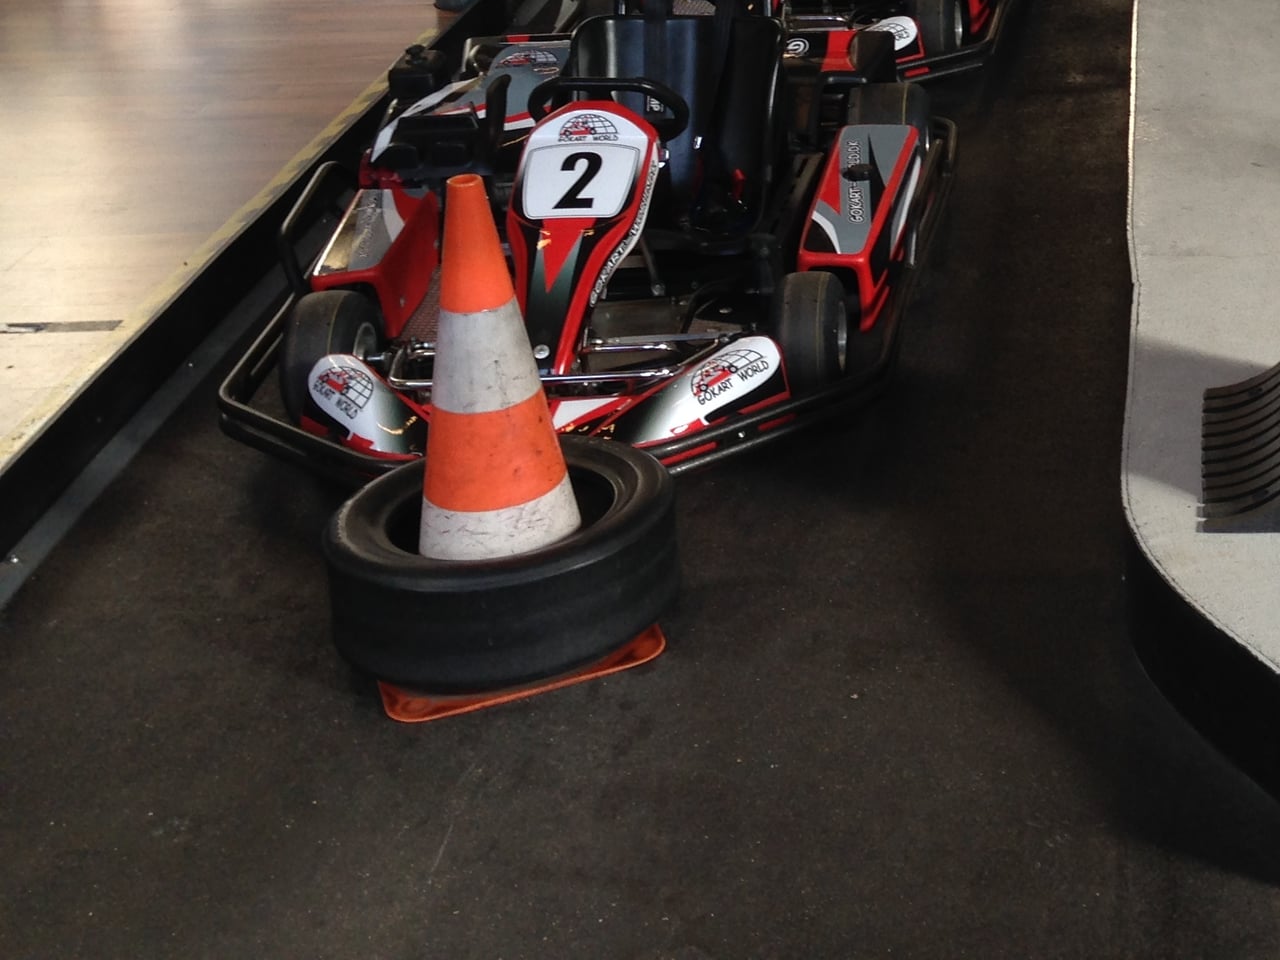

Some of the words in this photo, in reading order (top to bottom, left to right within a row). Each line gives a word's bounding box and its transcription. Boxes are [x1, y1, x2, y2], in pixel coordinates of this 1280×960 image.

[552, 151, 603, 209] 2
[697, 378, 734, 406] GOKART
[737, 360, 770, 382] WORLD
